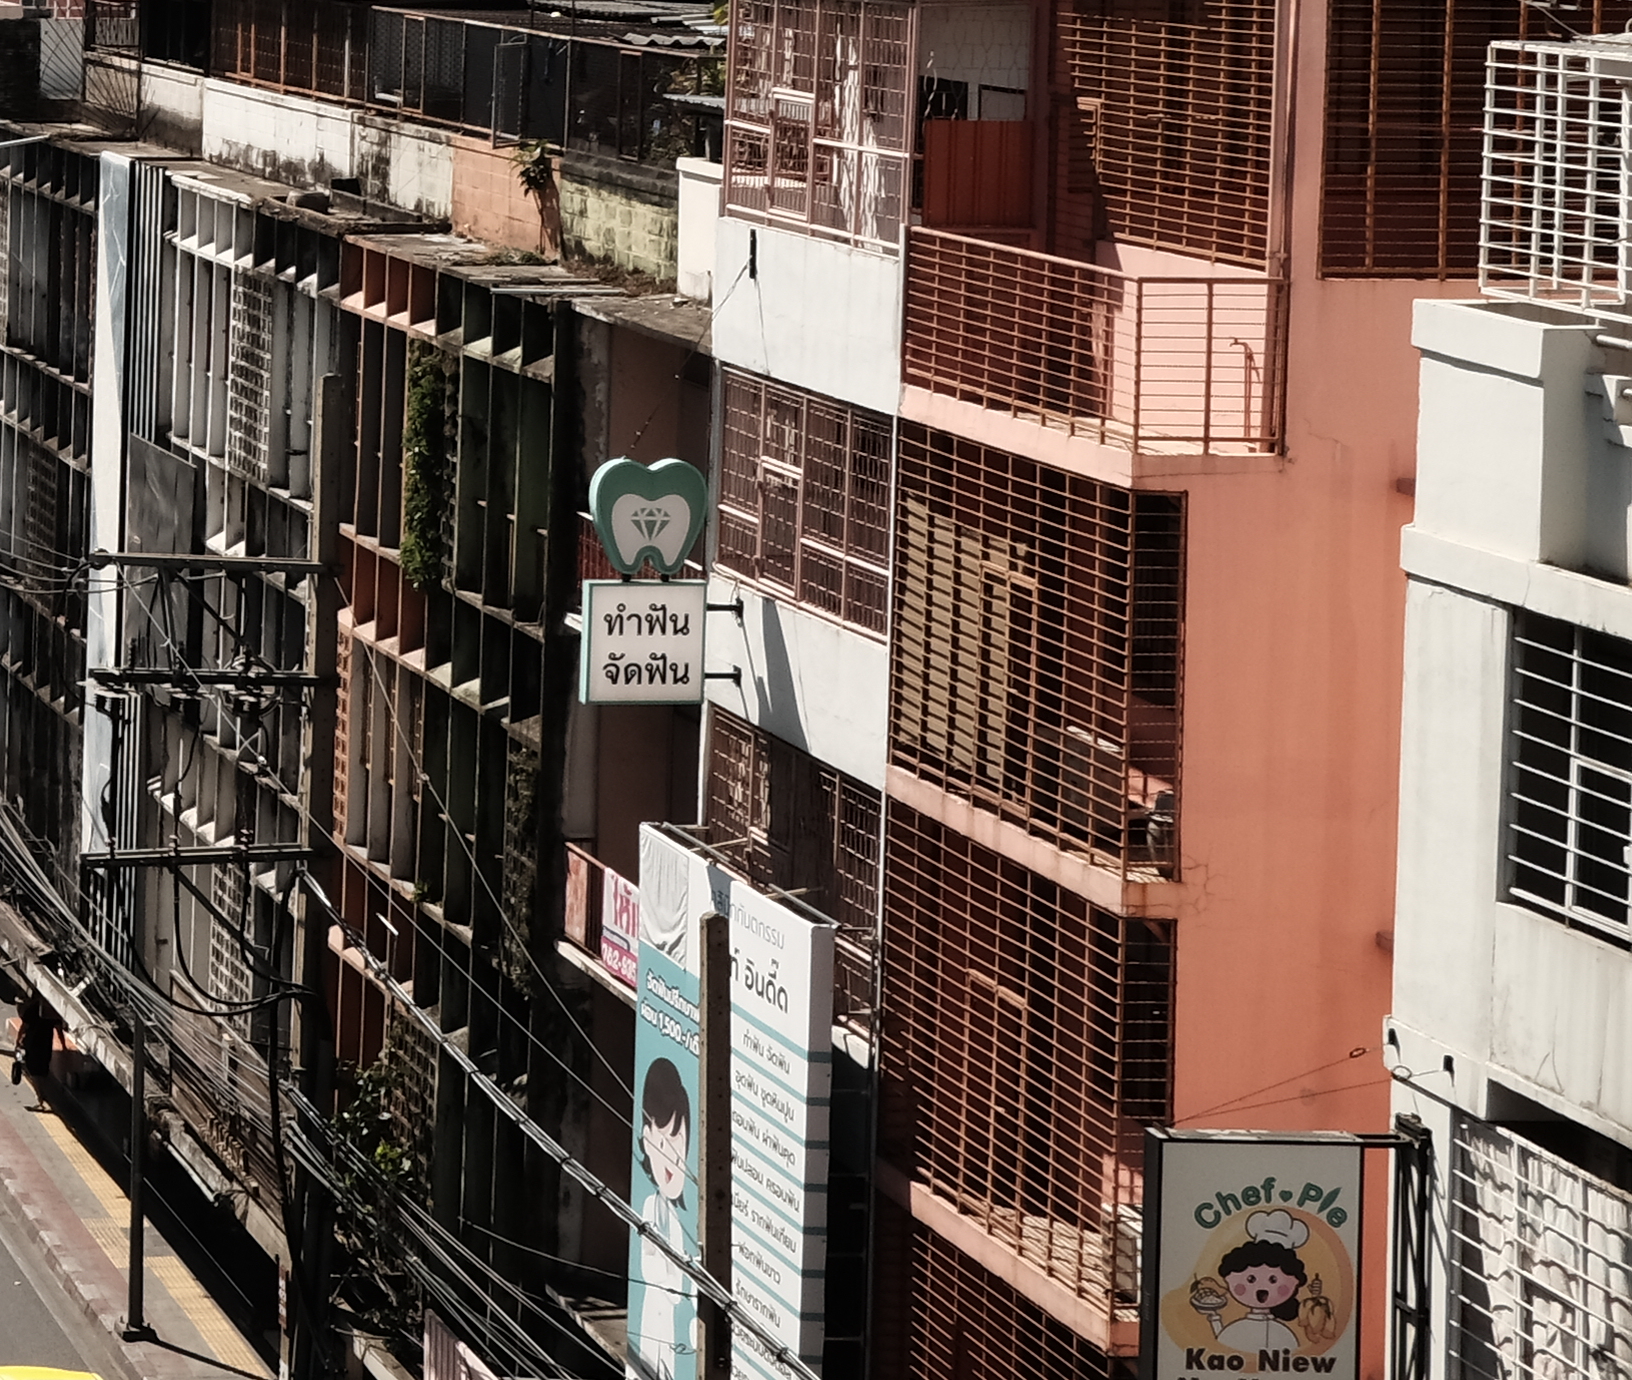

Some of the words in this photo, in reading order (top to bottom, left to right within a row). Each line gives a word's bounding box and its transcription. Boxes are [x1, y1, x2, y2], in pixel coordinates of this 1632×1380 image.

[603, 602, 690, 636] ทำฟัน
[602, 651, 690, 685] จัดฟัน
[1194, 1176, 1277, 1229] Chef
[1186, 1347, 1244, 1371] Kao
[1258, 1348, 1337, 1374] Niew
